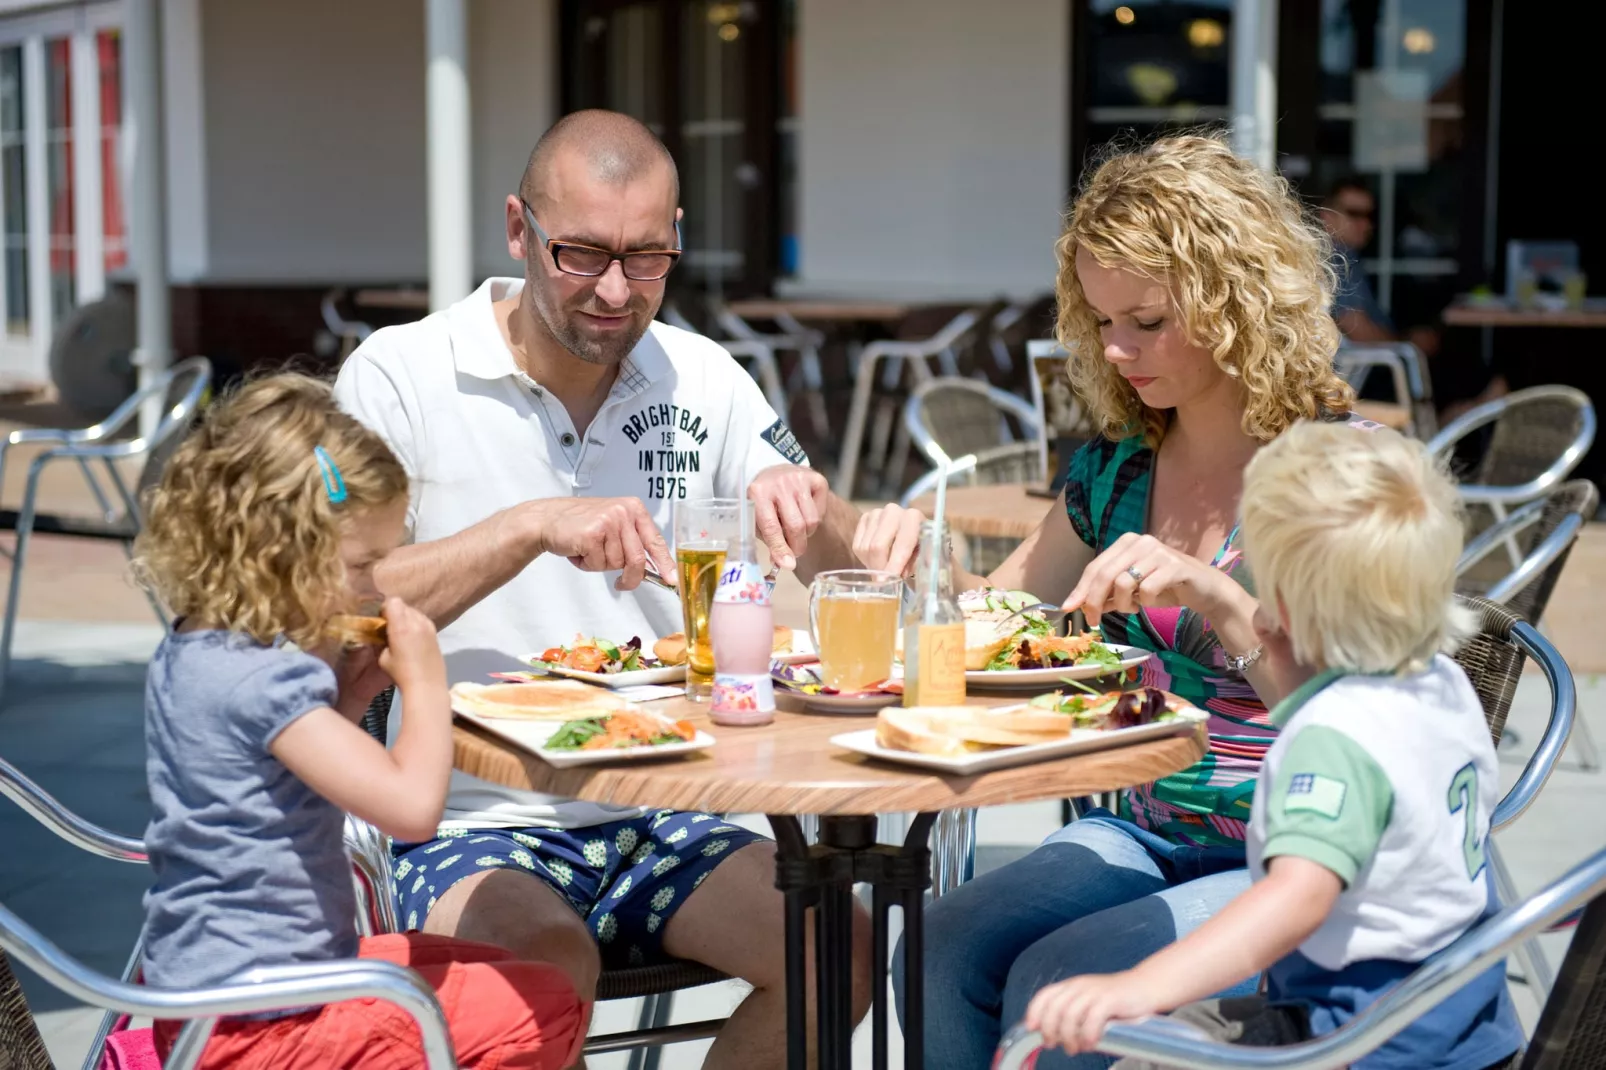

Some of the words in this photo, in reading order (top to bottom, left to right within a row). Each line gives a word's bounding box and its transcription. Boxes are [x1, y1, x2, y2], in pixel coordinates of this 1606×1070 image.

[661, 431, 676, 447] 1ST
[639, 450, 653, 471] IN
[657, 450, 700, 472] TOWN
[648, 476, 687, 499] 1976
